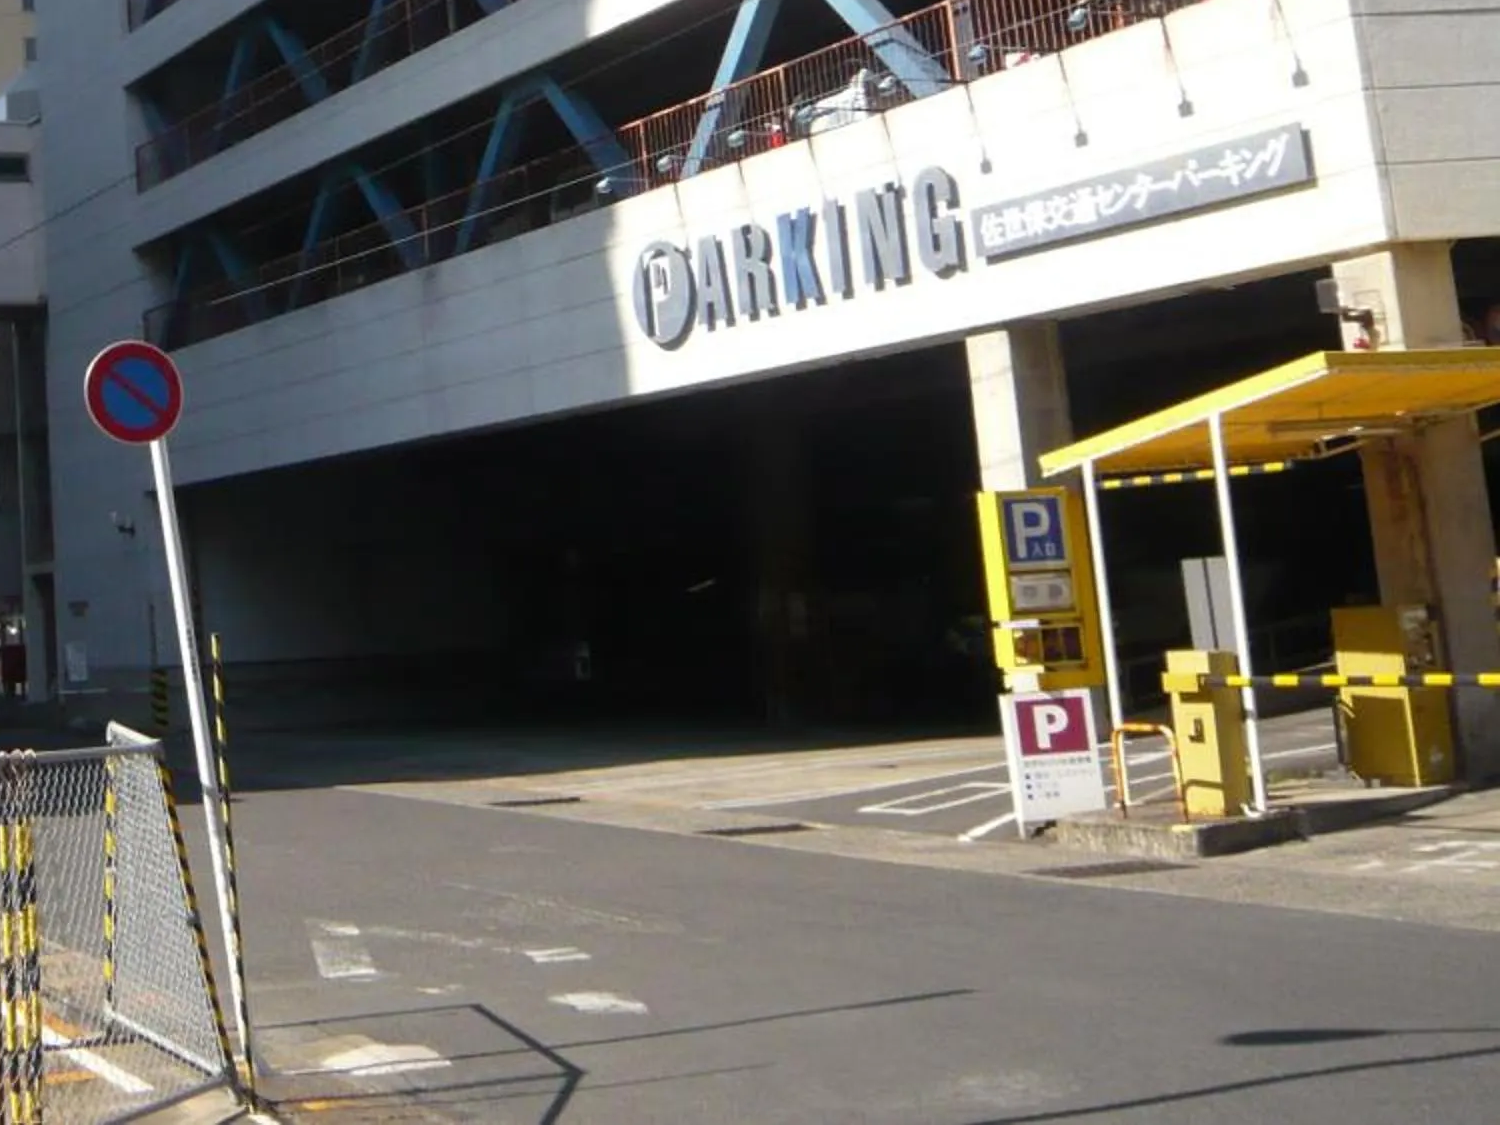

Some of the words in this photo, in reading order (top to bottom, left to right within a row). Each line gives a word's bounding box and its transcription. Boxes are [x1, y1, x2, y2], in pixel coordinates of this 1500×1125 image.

[1011, 502, 1050, 558] P
[1031, 541, 1057, 558] 入口
[1032, 704, 1069, 750] P
